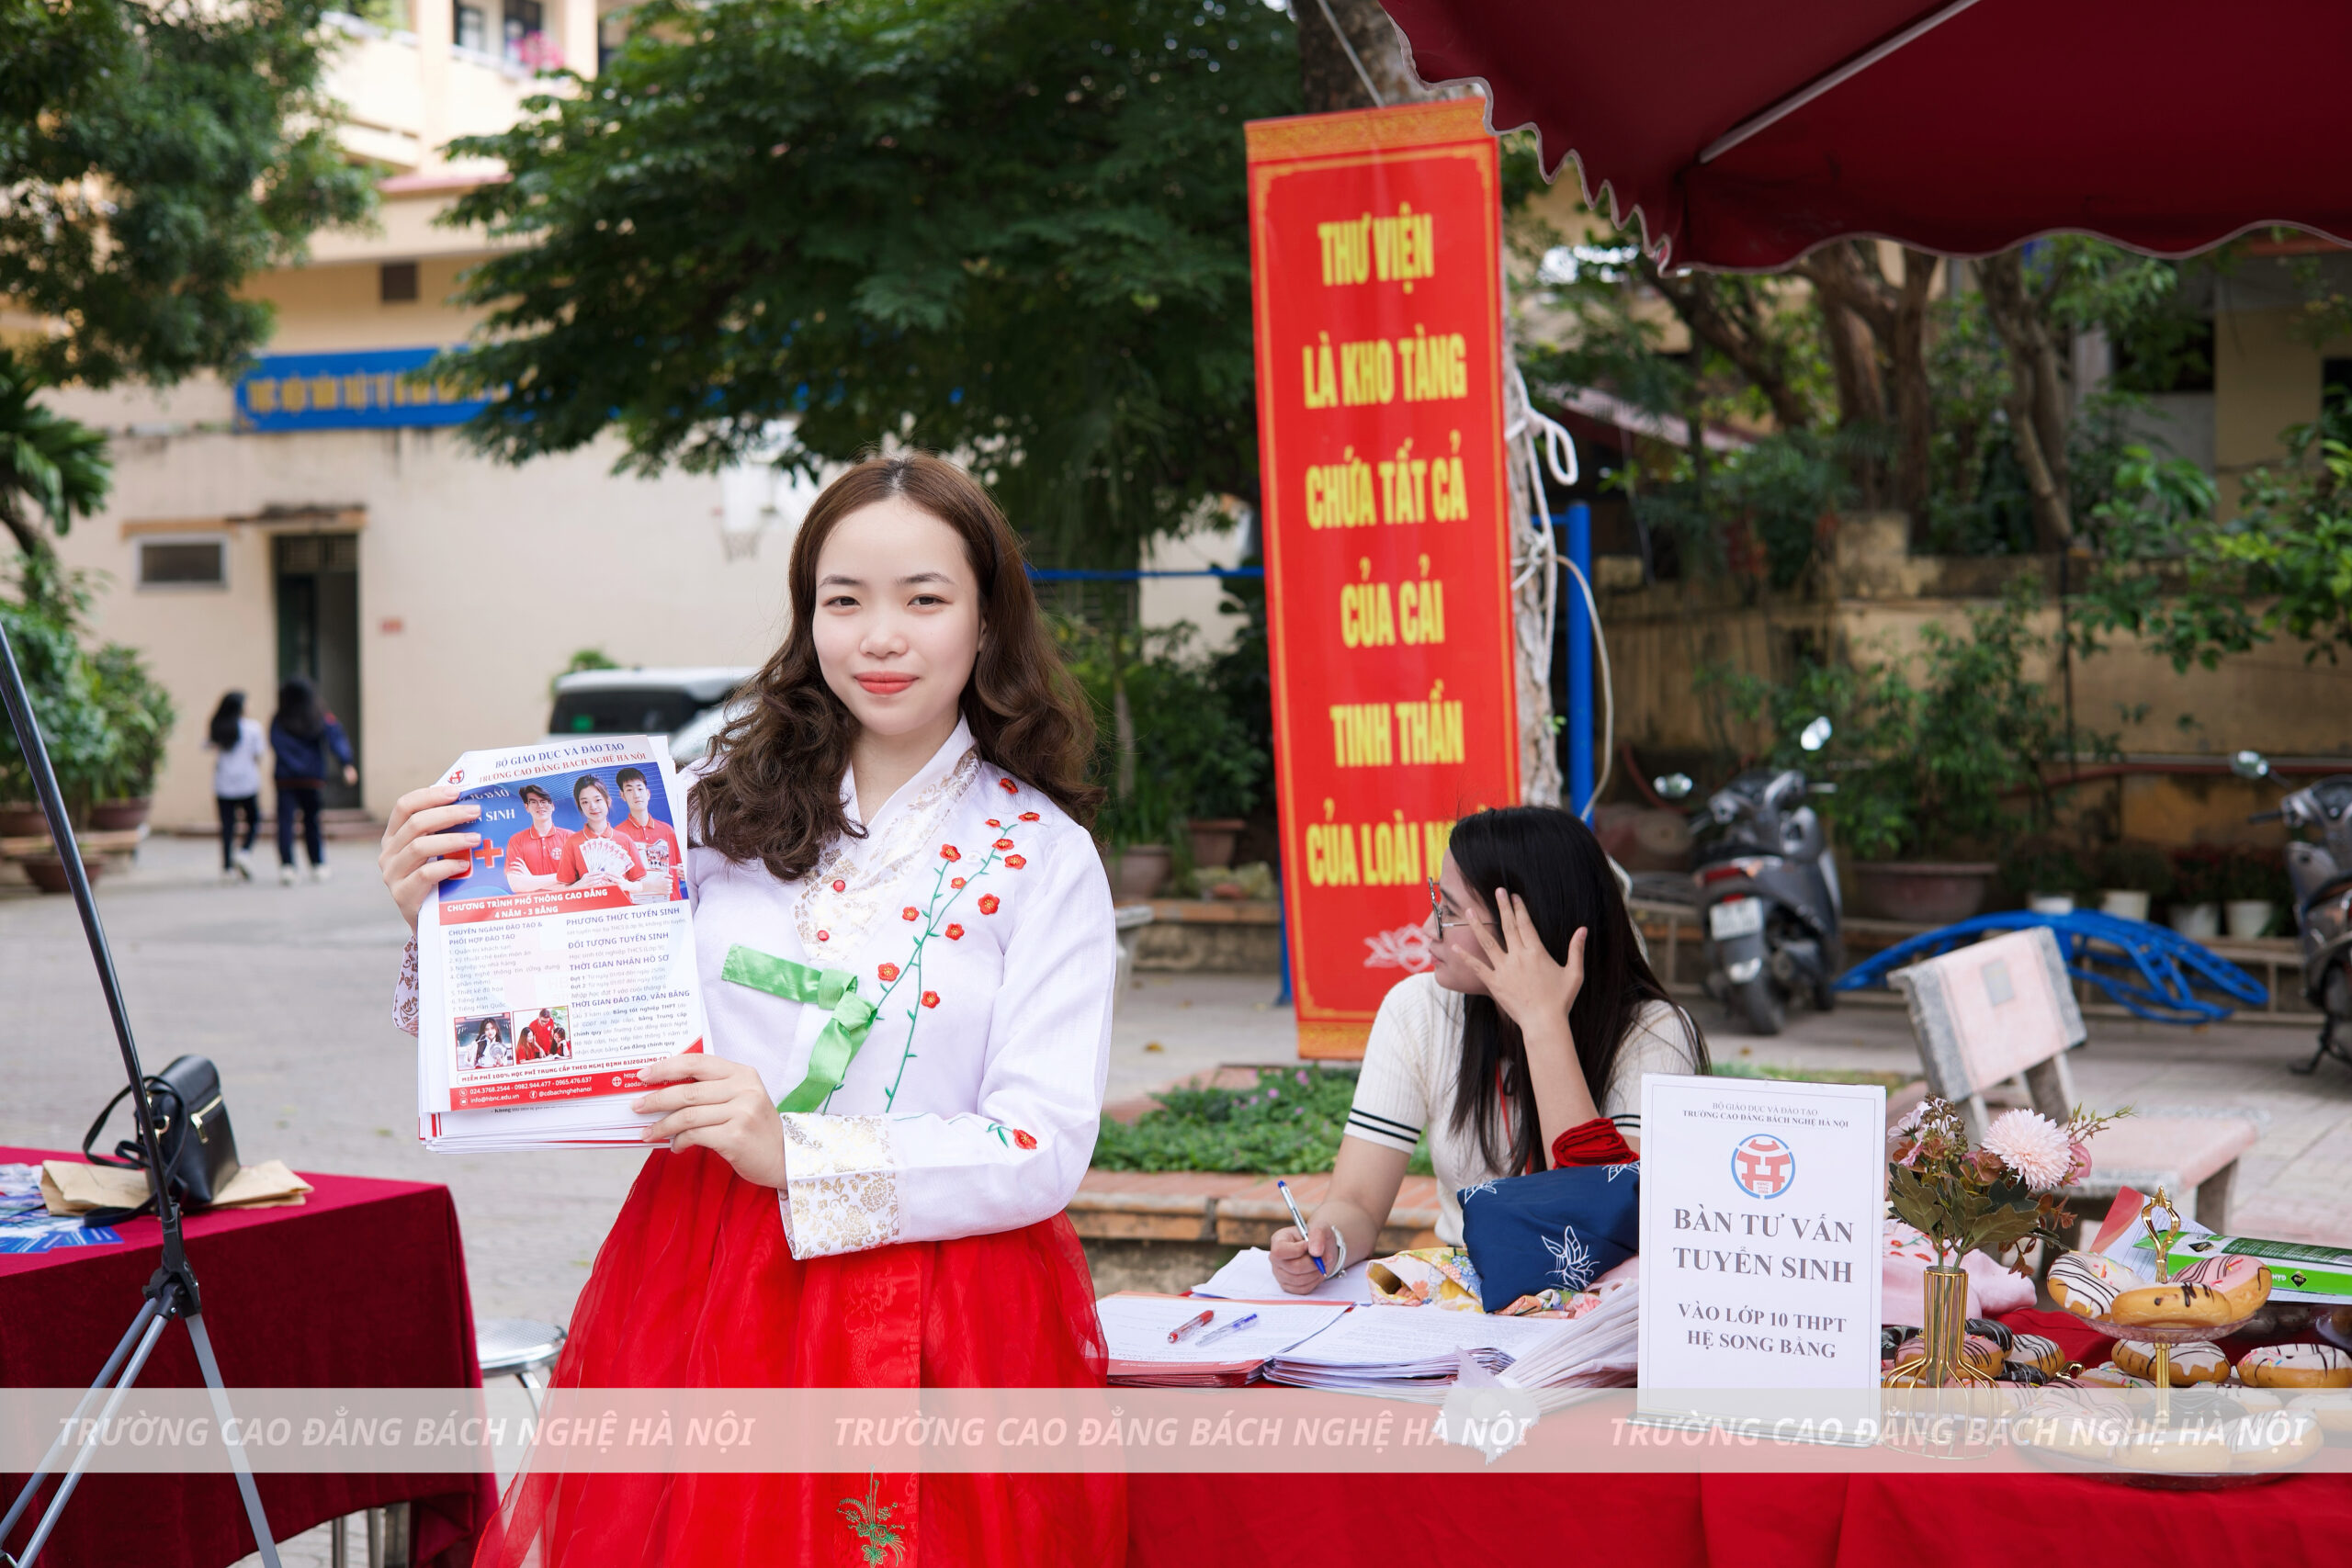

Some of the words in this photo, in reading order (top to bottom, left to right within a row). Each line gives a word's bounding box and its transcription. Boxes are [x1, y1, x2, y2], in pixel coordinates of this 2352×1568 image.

[1318, 212, 1371, 286] THƯ
[1373, 201, 1434, 294] VIỆN
[1303, 332, 1338, 409] LÀ
[1340, 340, 1394, 407] KHO
[1398, 324, 1467, 401] TÀNG
[1306, 446, 1375, 529] CHỨA
[1378, 437, 1427, 525] TẤT
[1431, 430, 1468, 523] CẢ
[1340, 558, 1395, 648] CỦA
[1399, 554, 1444, 644] CẢI
[1330, 703, 1392, 767] TINH
[486, 808, 514, 822] SINH
[1306, 798, 1360, 886] CỦA
[1362, 810, 1420, 886] LOÀI
[447, 900, 484, 912] CHƯƠNG
[487, 898, 513, 908] TRÌNH
[514, 896, 532, 906] PHỔ
[534, 892, 563, 904] THÔNG
[565, 892, 582, 900] CAO
[583, 888, 607, 898] ĐẲNG
[502, 908, 521, 918] NĂM
[535, 906, 559, 915] BẰNG
[1683, 1109, 1718, 1119] TRƯỜNG
[1767, 1114, 1790, 1123] BÁCH
[1792, 1118, 1816, 1127] NGHỆ
[1818, 1118, 1831, 1127] HÀ
[1834, 1120, 1849, 1129] NỘI
[1674, 1204, 1732, 1234] BÀN
[1741, 1213, 1785, 1237] TƯ
[1792, 1213, 1854, 1244] VẤN
[1673, 1246, 1772, 1276] TUYỂN
[1781, 1257, 1853, 1283] SINH
[1678, 1301, 1720, 1321] VÀO
[1726, 1304, 1765, 1325] LỚP
[1771, 1312, 1788, 1327] 10
[1793, 1314, 1847, 1333] THPT
[1687, 1329, 1713, 1349] HỆ
[1720, 1333, 1773, 1353] SONG
[1780, 1336, 1837, 1359] BẰNG
